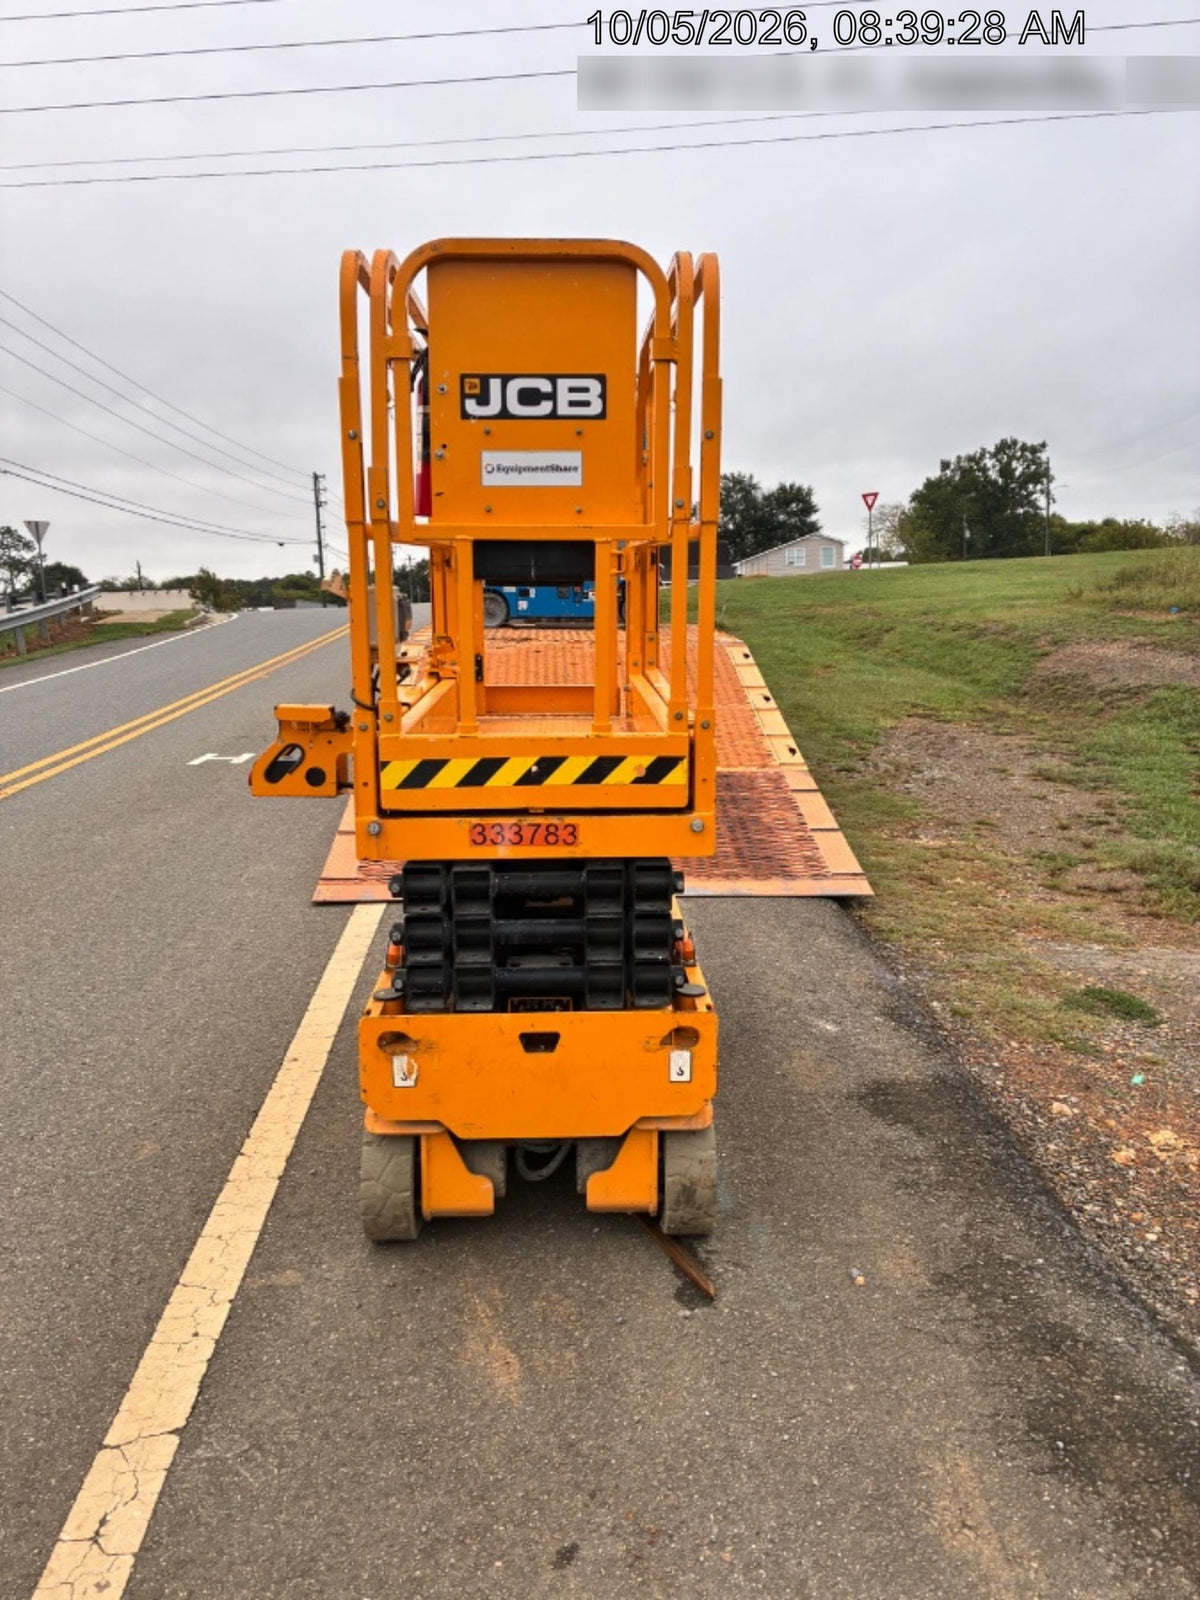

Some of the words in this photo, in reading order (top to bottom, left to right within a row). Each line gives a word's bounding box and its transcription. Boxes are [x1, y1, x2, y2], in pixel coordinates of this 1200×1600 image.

[464, 377, 603, 416] JCB
[496, 464, 579, 474] EquipmentShare
[471, 823, 577, 845] 333783
